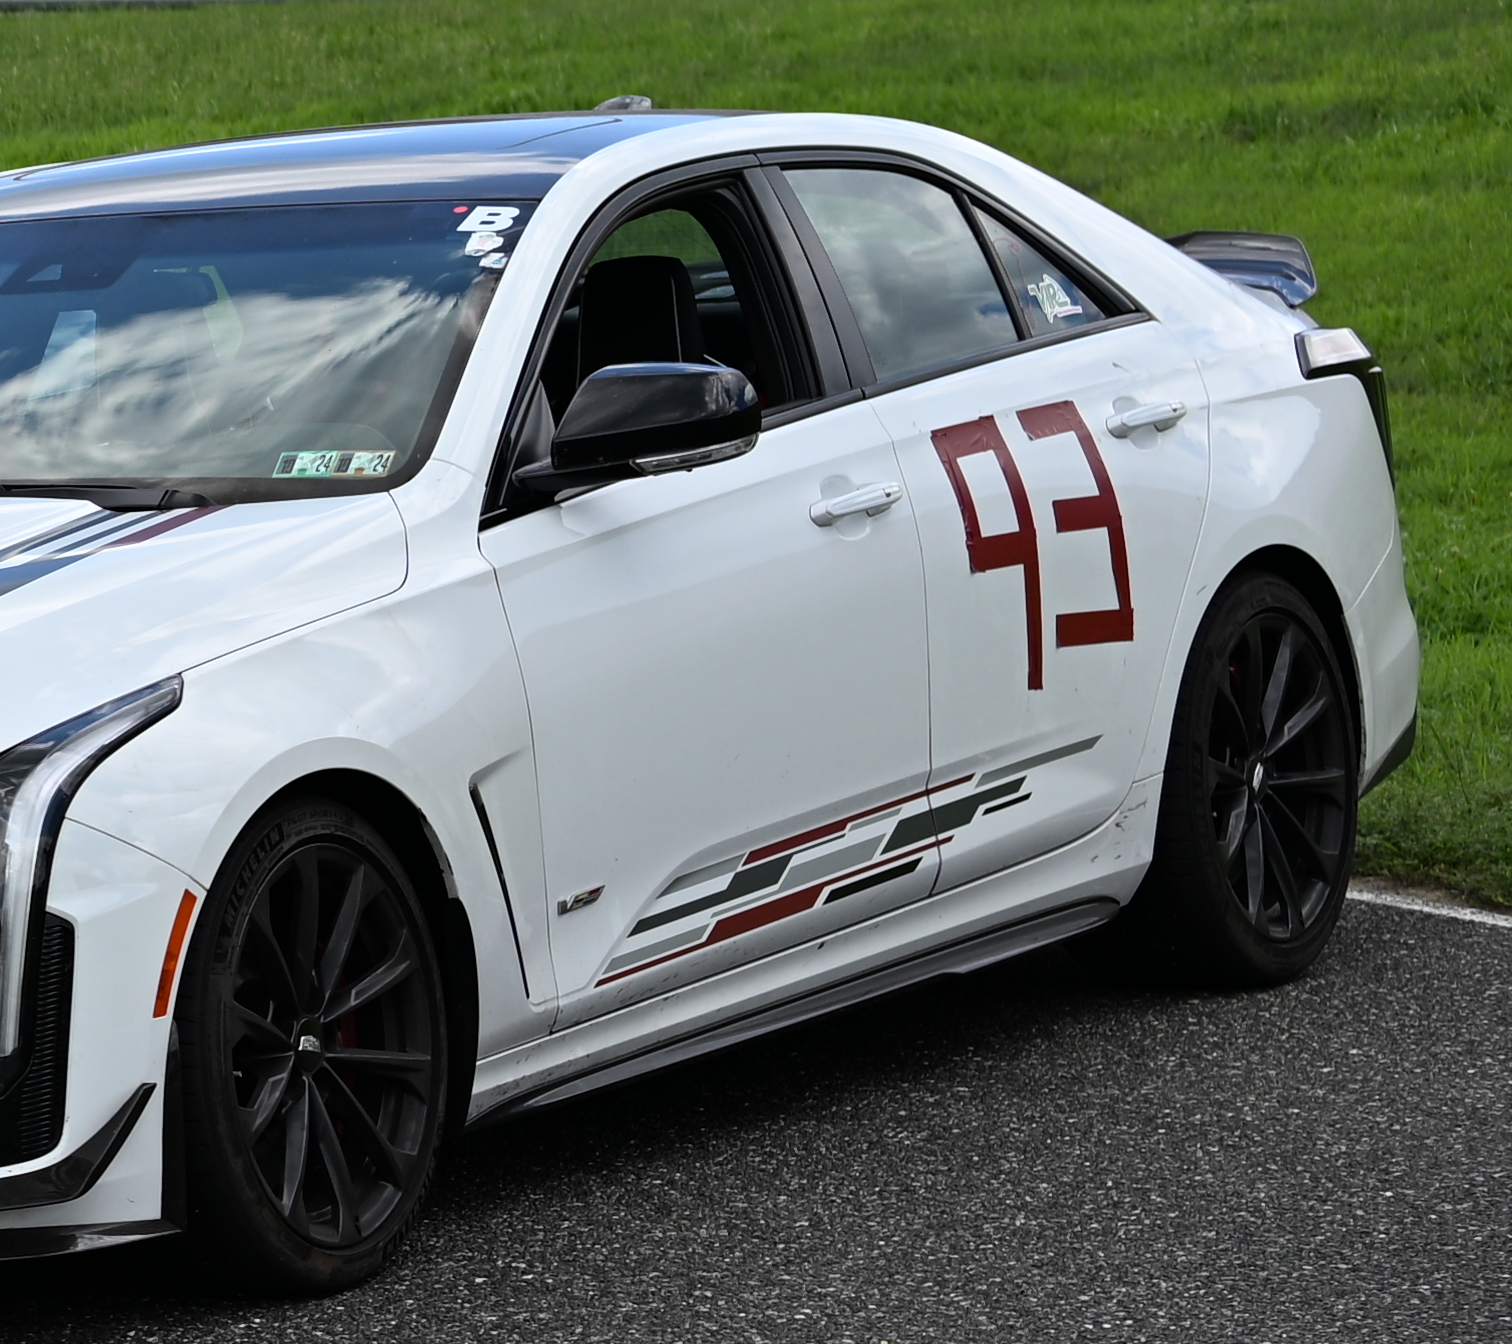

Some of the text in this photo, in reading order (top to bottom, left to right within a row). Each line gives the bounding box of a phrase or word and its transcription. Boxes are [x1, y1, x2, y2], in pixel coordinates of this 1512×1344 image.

[455, 205, 520, 232] B
[315, 454, 334, 473] 24
[372, 454, 392, 473] 24
[930, 399, 1134, 691] 93
[224, 824, 284, 928] MICHELIN
